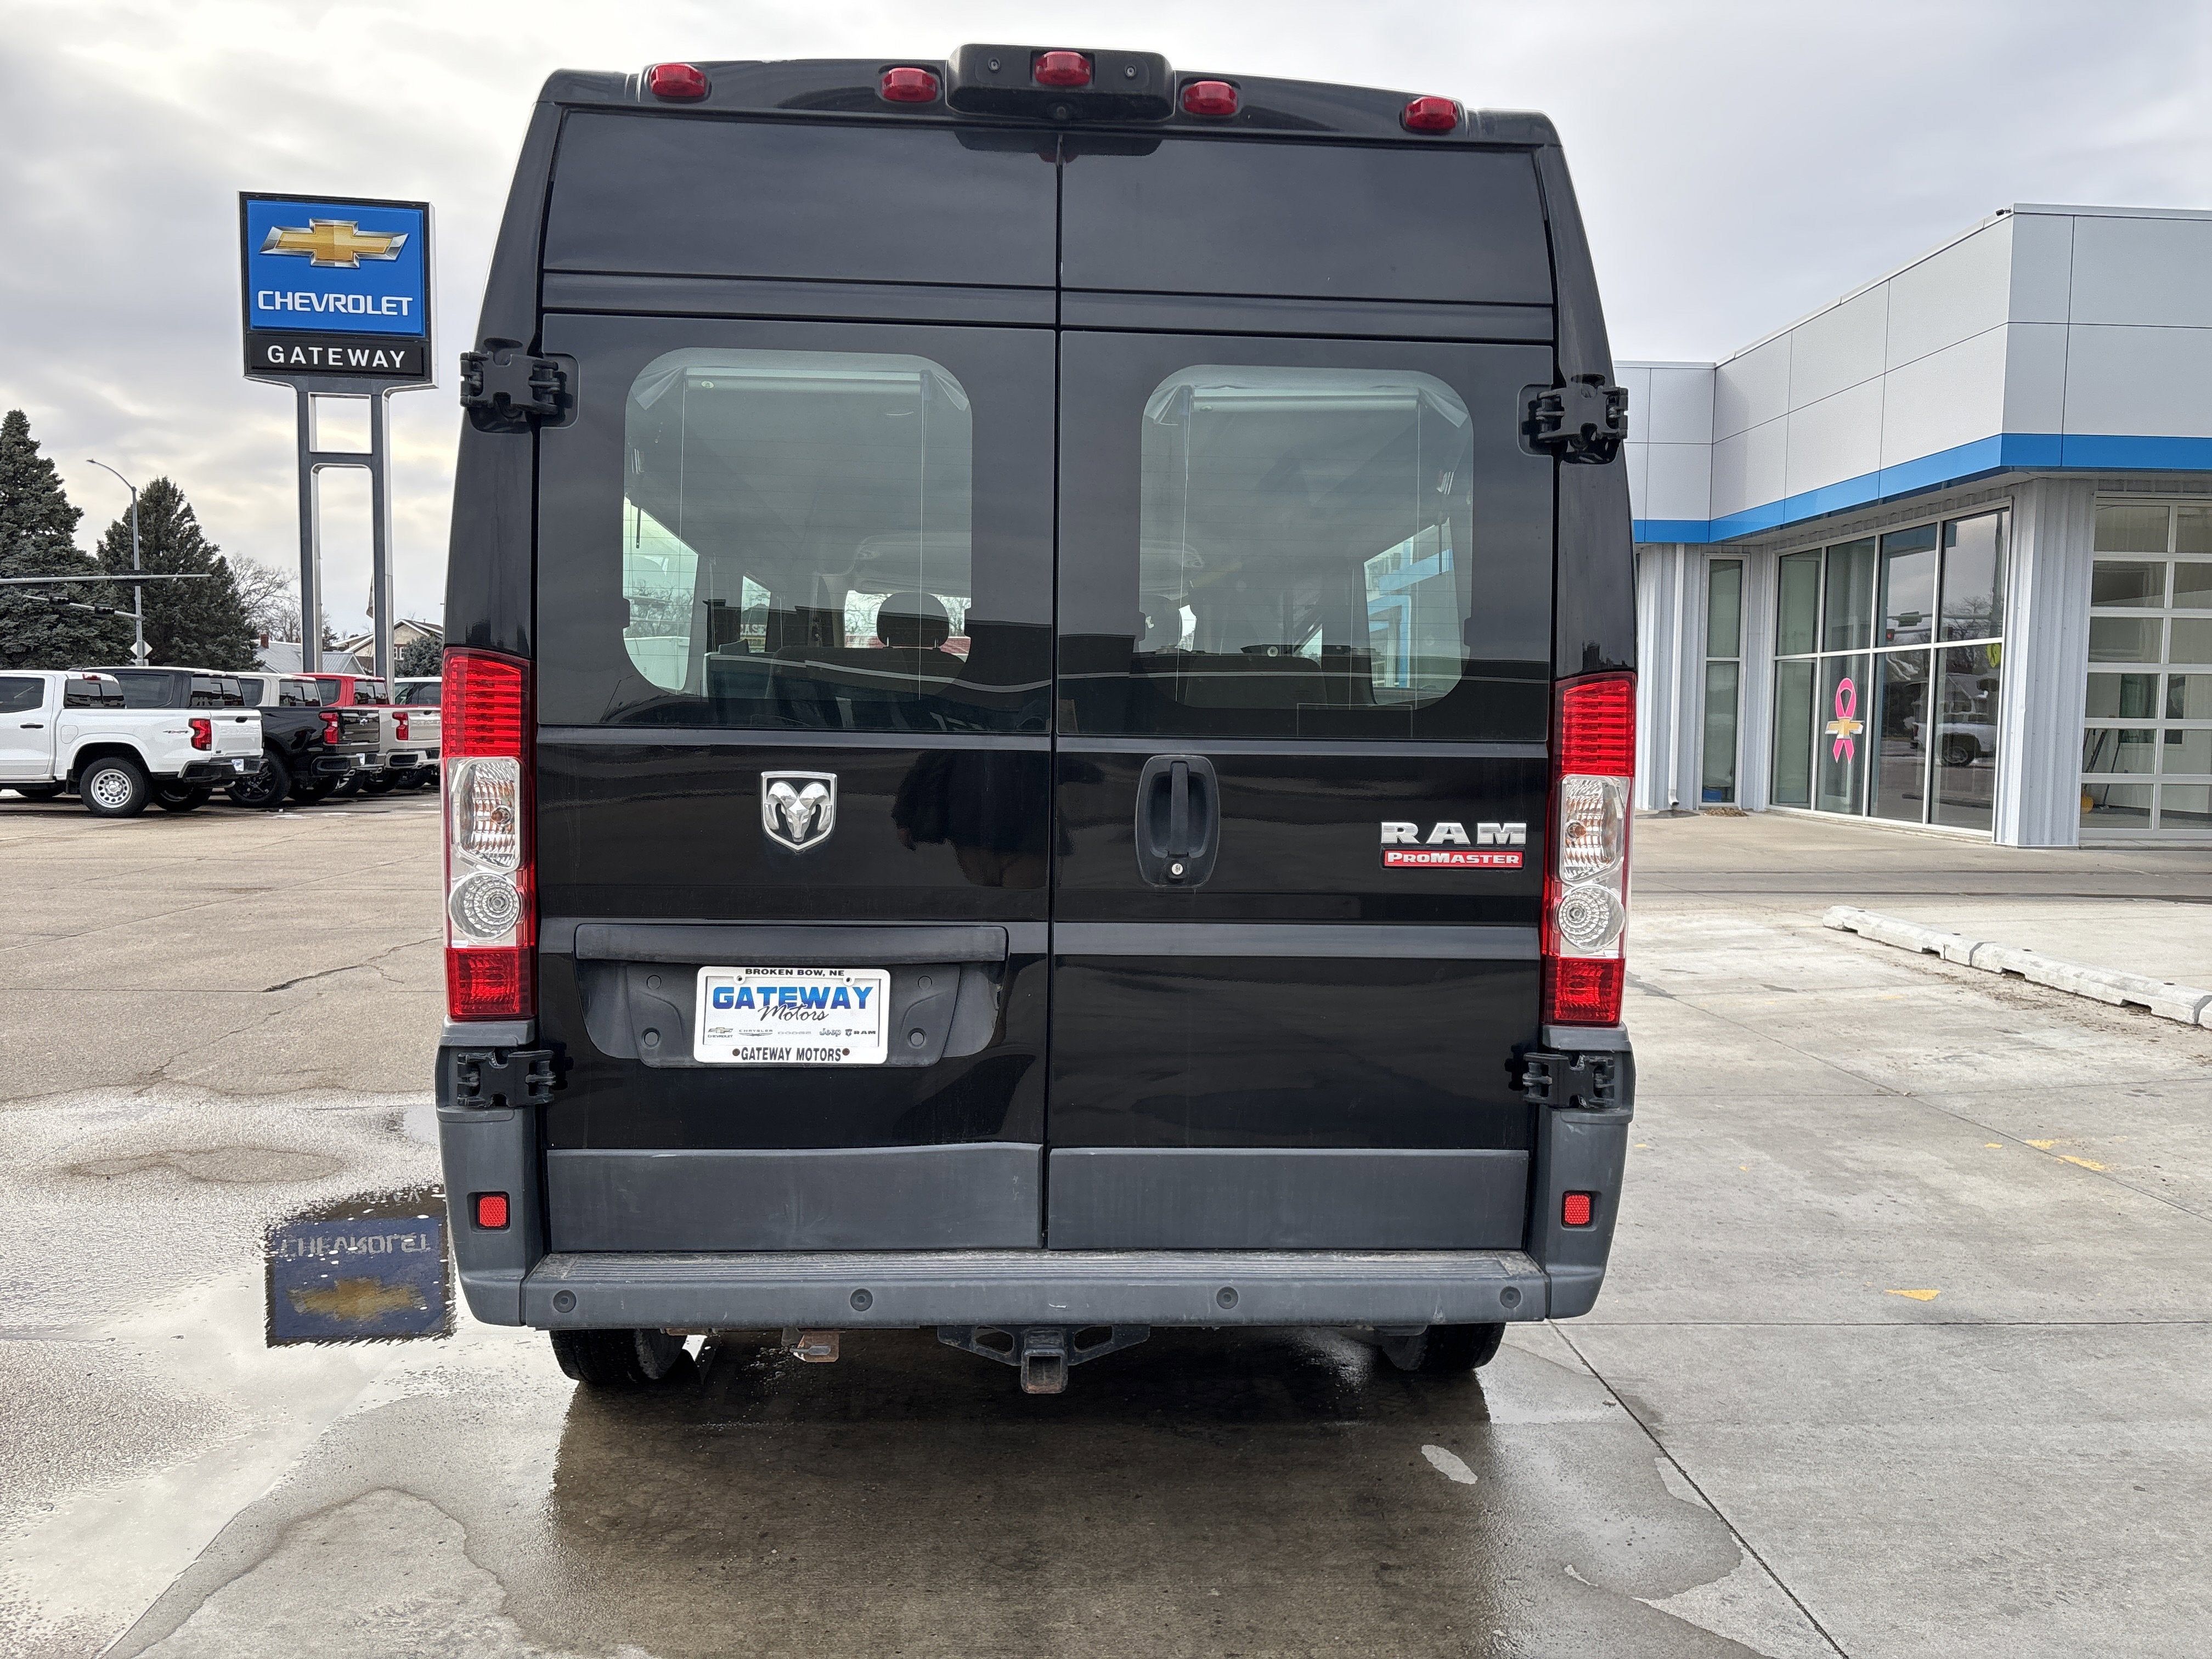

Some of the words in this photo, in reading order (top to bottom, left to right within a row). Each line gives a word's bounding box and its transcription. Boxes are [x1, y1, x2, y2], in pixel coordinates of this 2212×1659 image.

[258, 290, 413, 316] CHEVROLET
[267, 345, 405, 368] GATEWAY
[1380, 822, 1526, 844] RAM
[797, 969, 825, 977] BOW,
[713, 986, 873, 1009] GATEWAY
[757, 1003, 829, 1021] Motors
[819, 1028, 842, 1037] Jeep
[741, 1047, 792, 1060] GATEWAY
[796, 1048, 841, 1062] MOTORS
